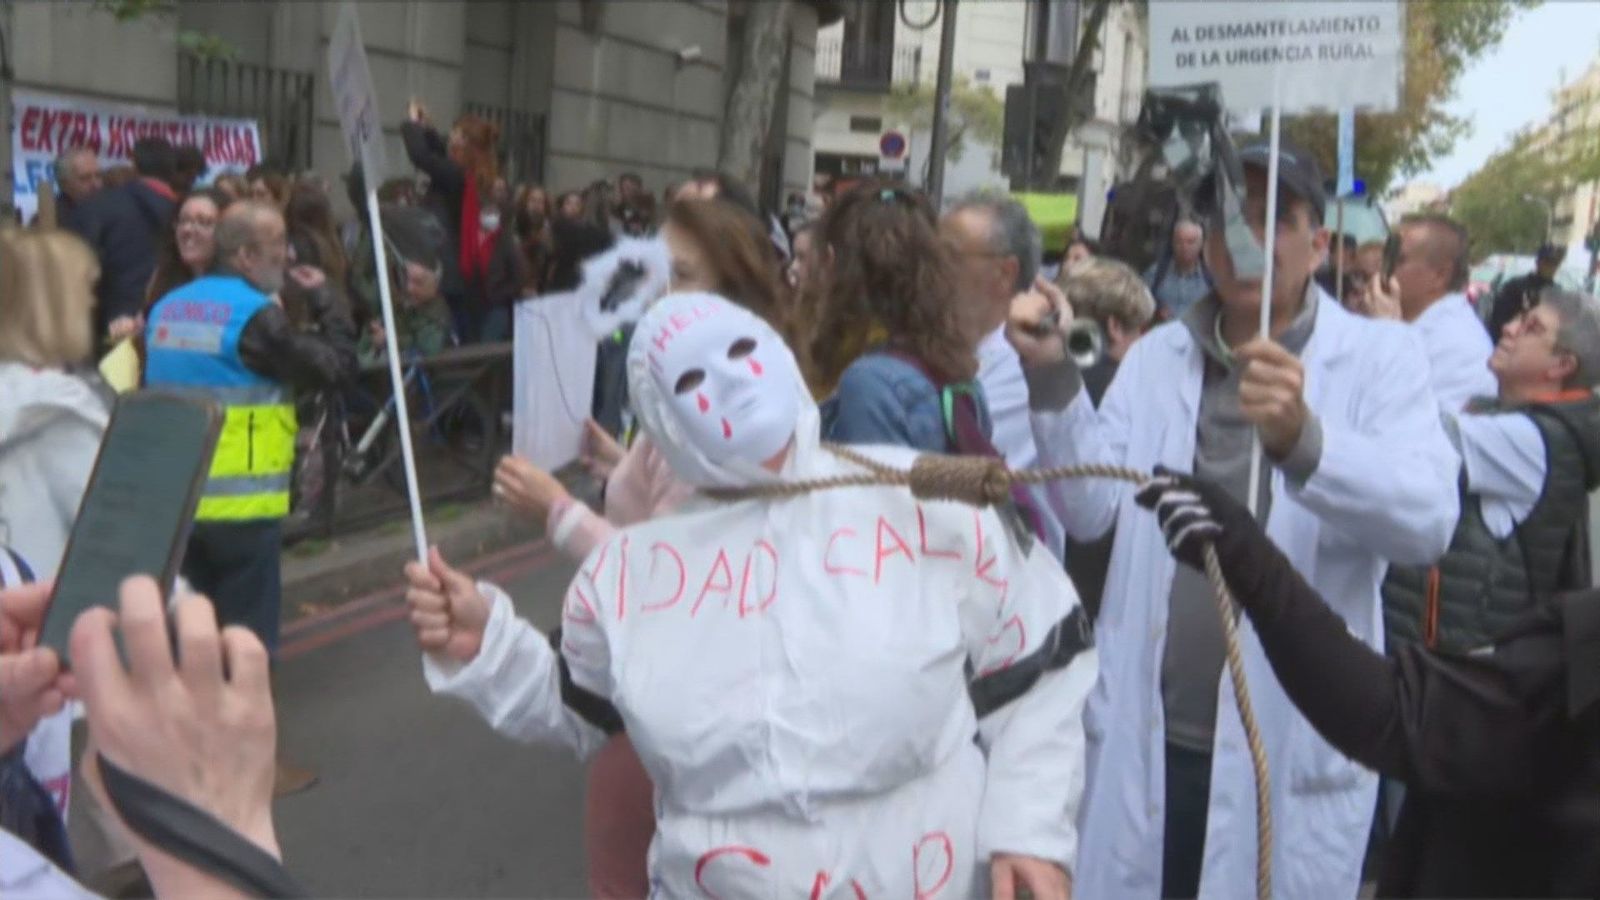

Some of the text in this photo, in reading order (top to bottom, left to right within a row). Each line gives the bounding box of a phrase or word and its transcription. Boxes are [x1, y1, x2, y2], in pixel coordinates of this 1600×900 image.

[1171, 15, 1380, 43] AL DESMANTELAMIENTO
[1176, 41, 1376, 68] DE LA URGENCIA RURAL
[21, 106, 102, 156] EXTRA
